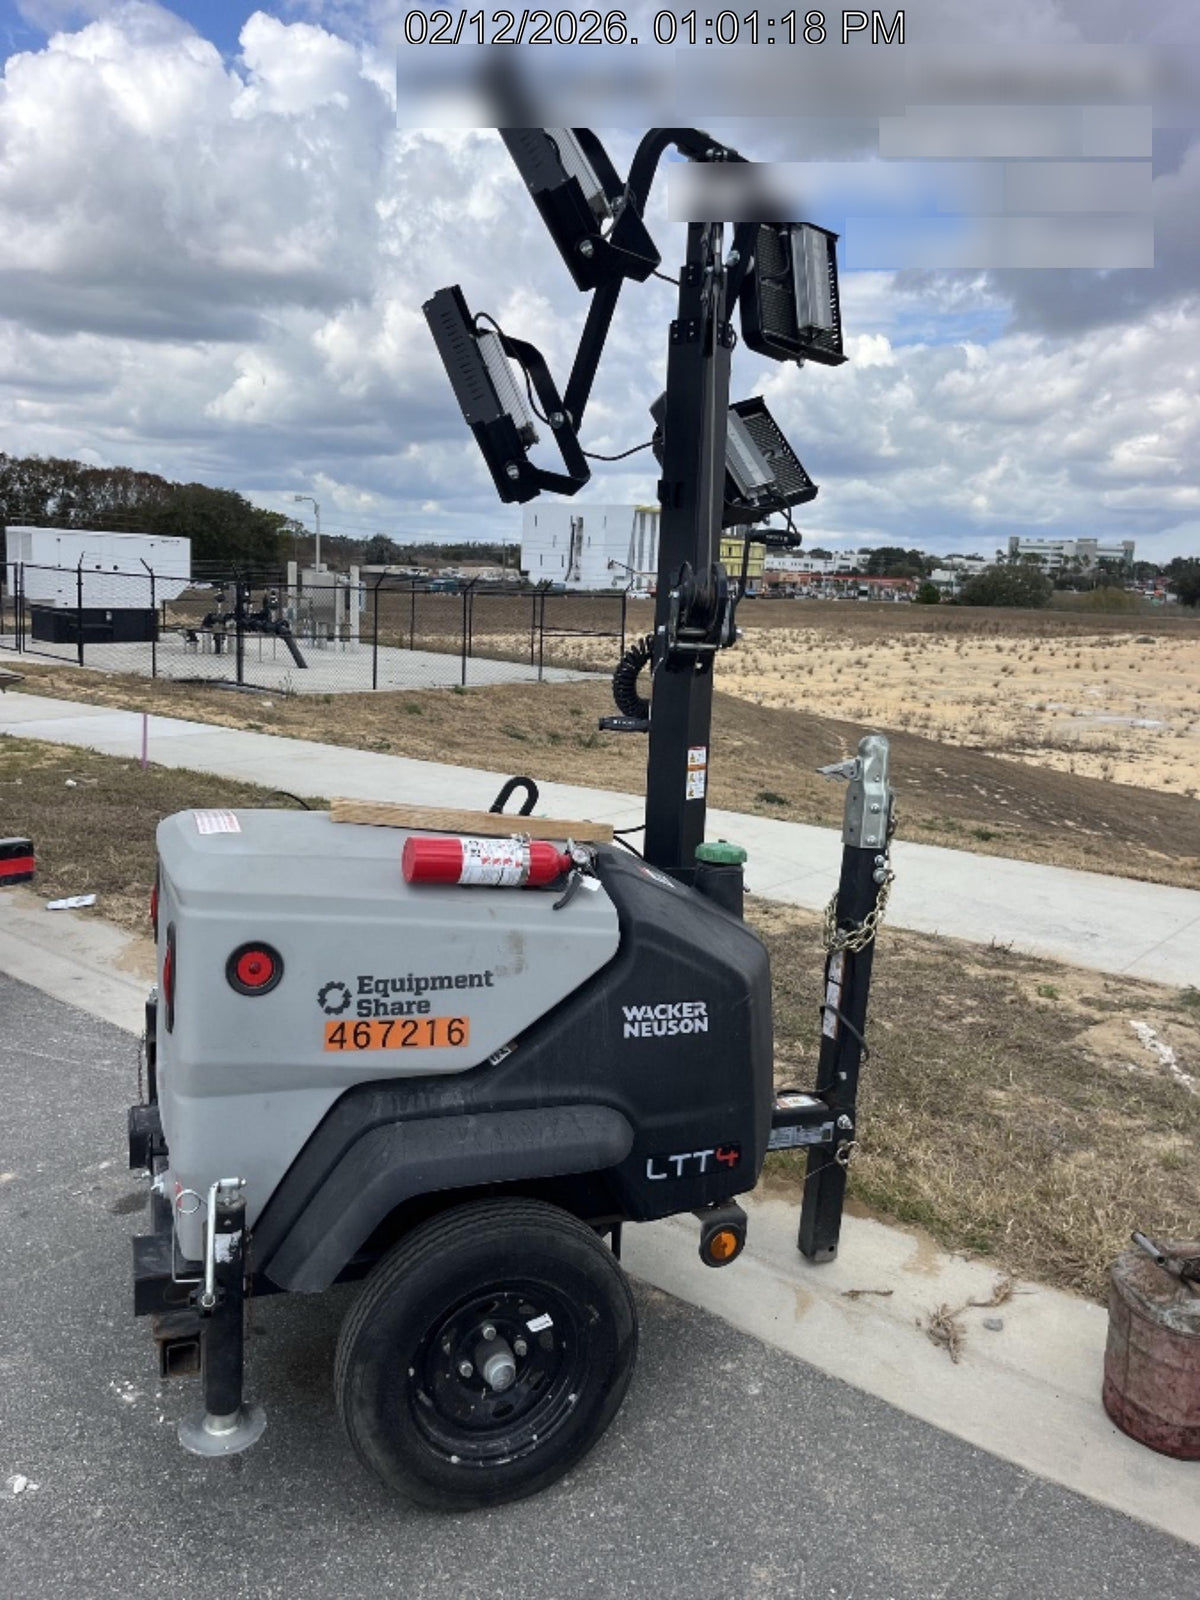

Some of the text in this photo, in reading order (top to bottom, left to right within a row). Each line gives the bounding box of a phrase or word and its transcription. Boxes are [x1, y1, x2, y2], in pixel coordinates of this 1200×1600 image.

[357, 970, 494, 997] Equipment
[357, 998, 431, 1017] Share
[622, 1001, 708, 1021] WACKER
[328, 1018, 465, 1049] 467216
[623, 1017, 708, 1039] NEUSON
